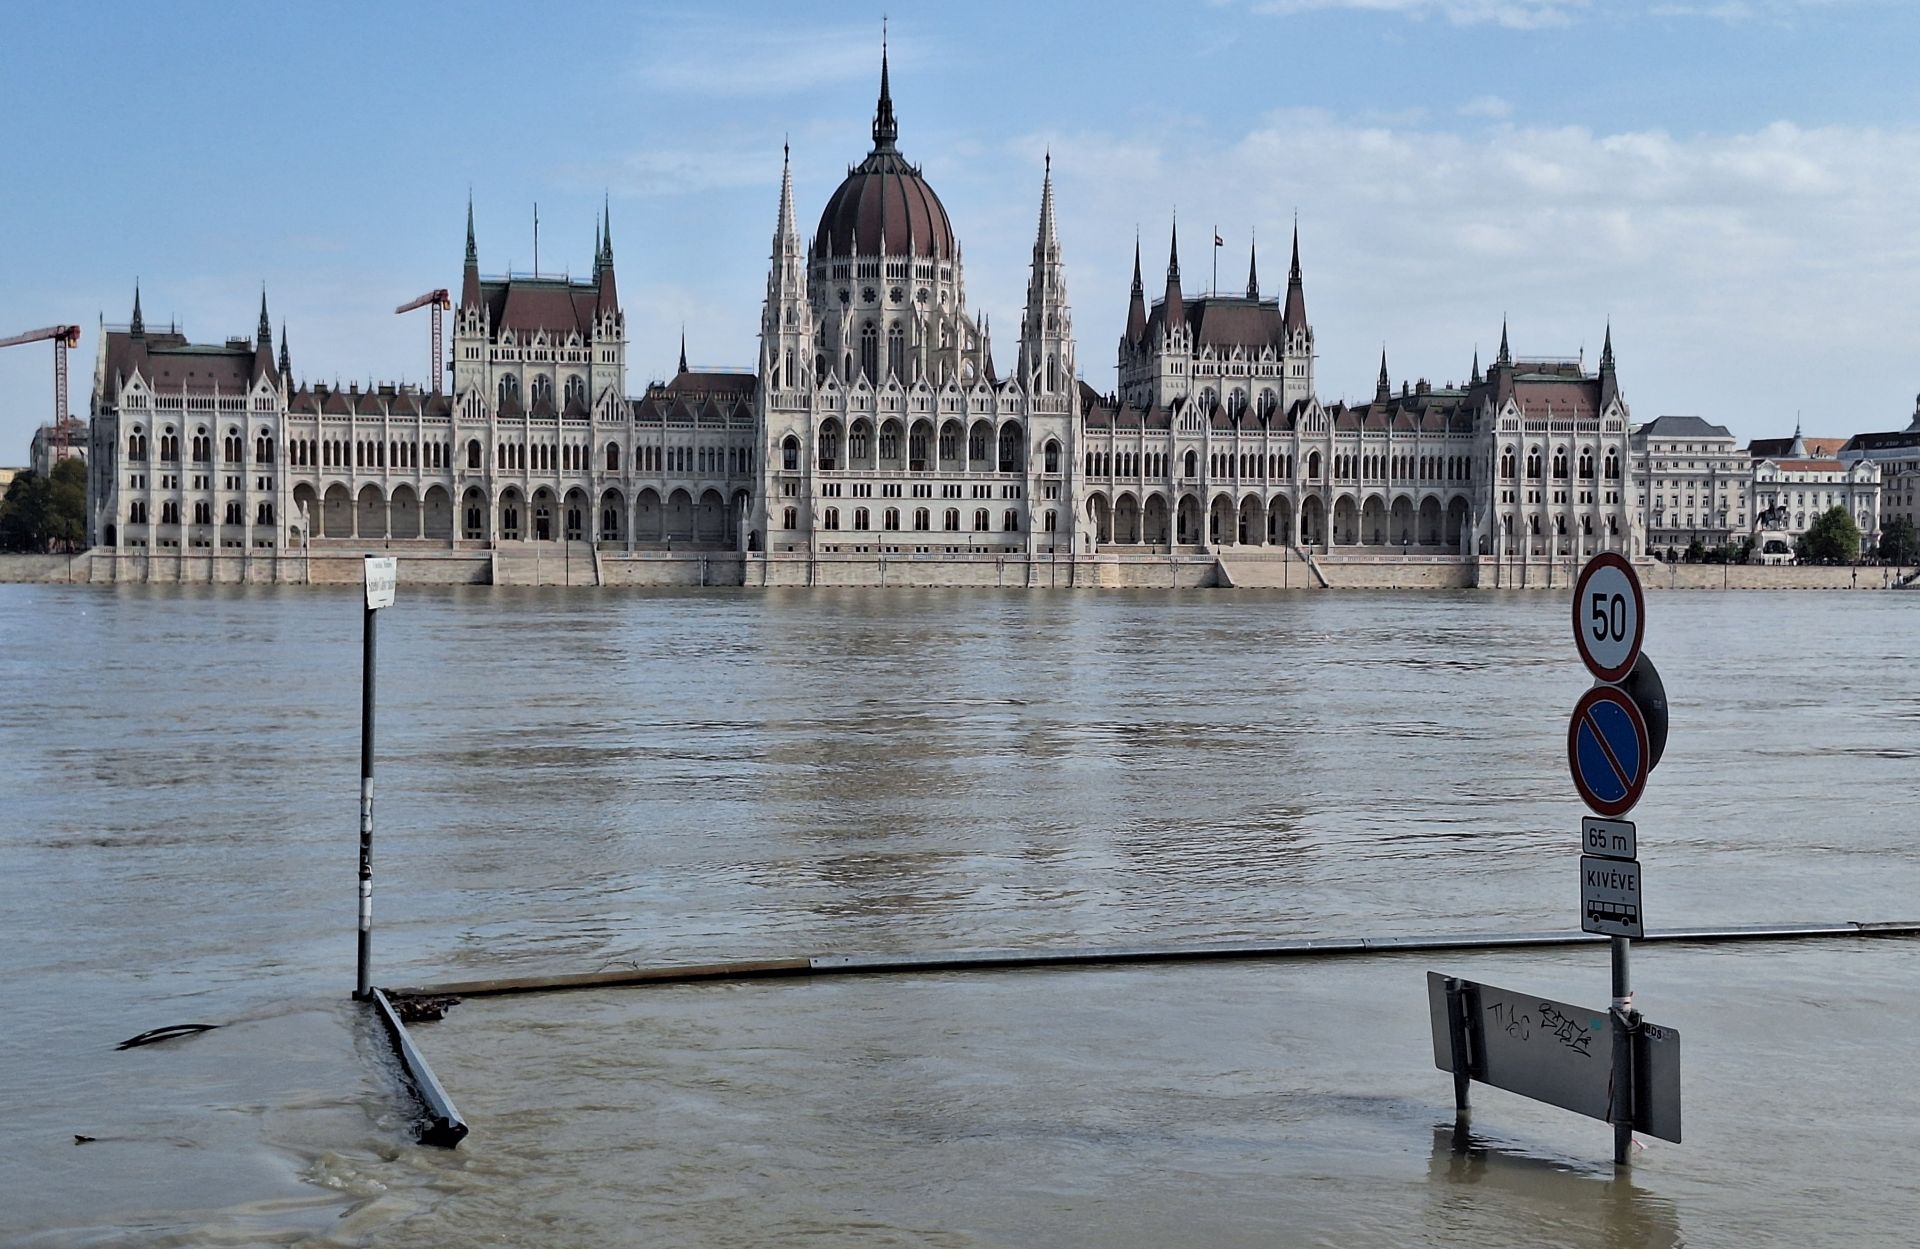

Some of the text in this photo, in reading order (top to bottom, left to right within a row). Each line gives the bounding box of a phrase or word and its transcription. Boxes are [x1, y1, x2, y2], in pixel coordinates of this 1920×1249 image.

[1592, 593, 1626, 642] 50
[1589, 827, 1627, 851] 65 m
